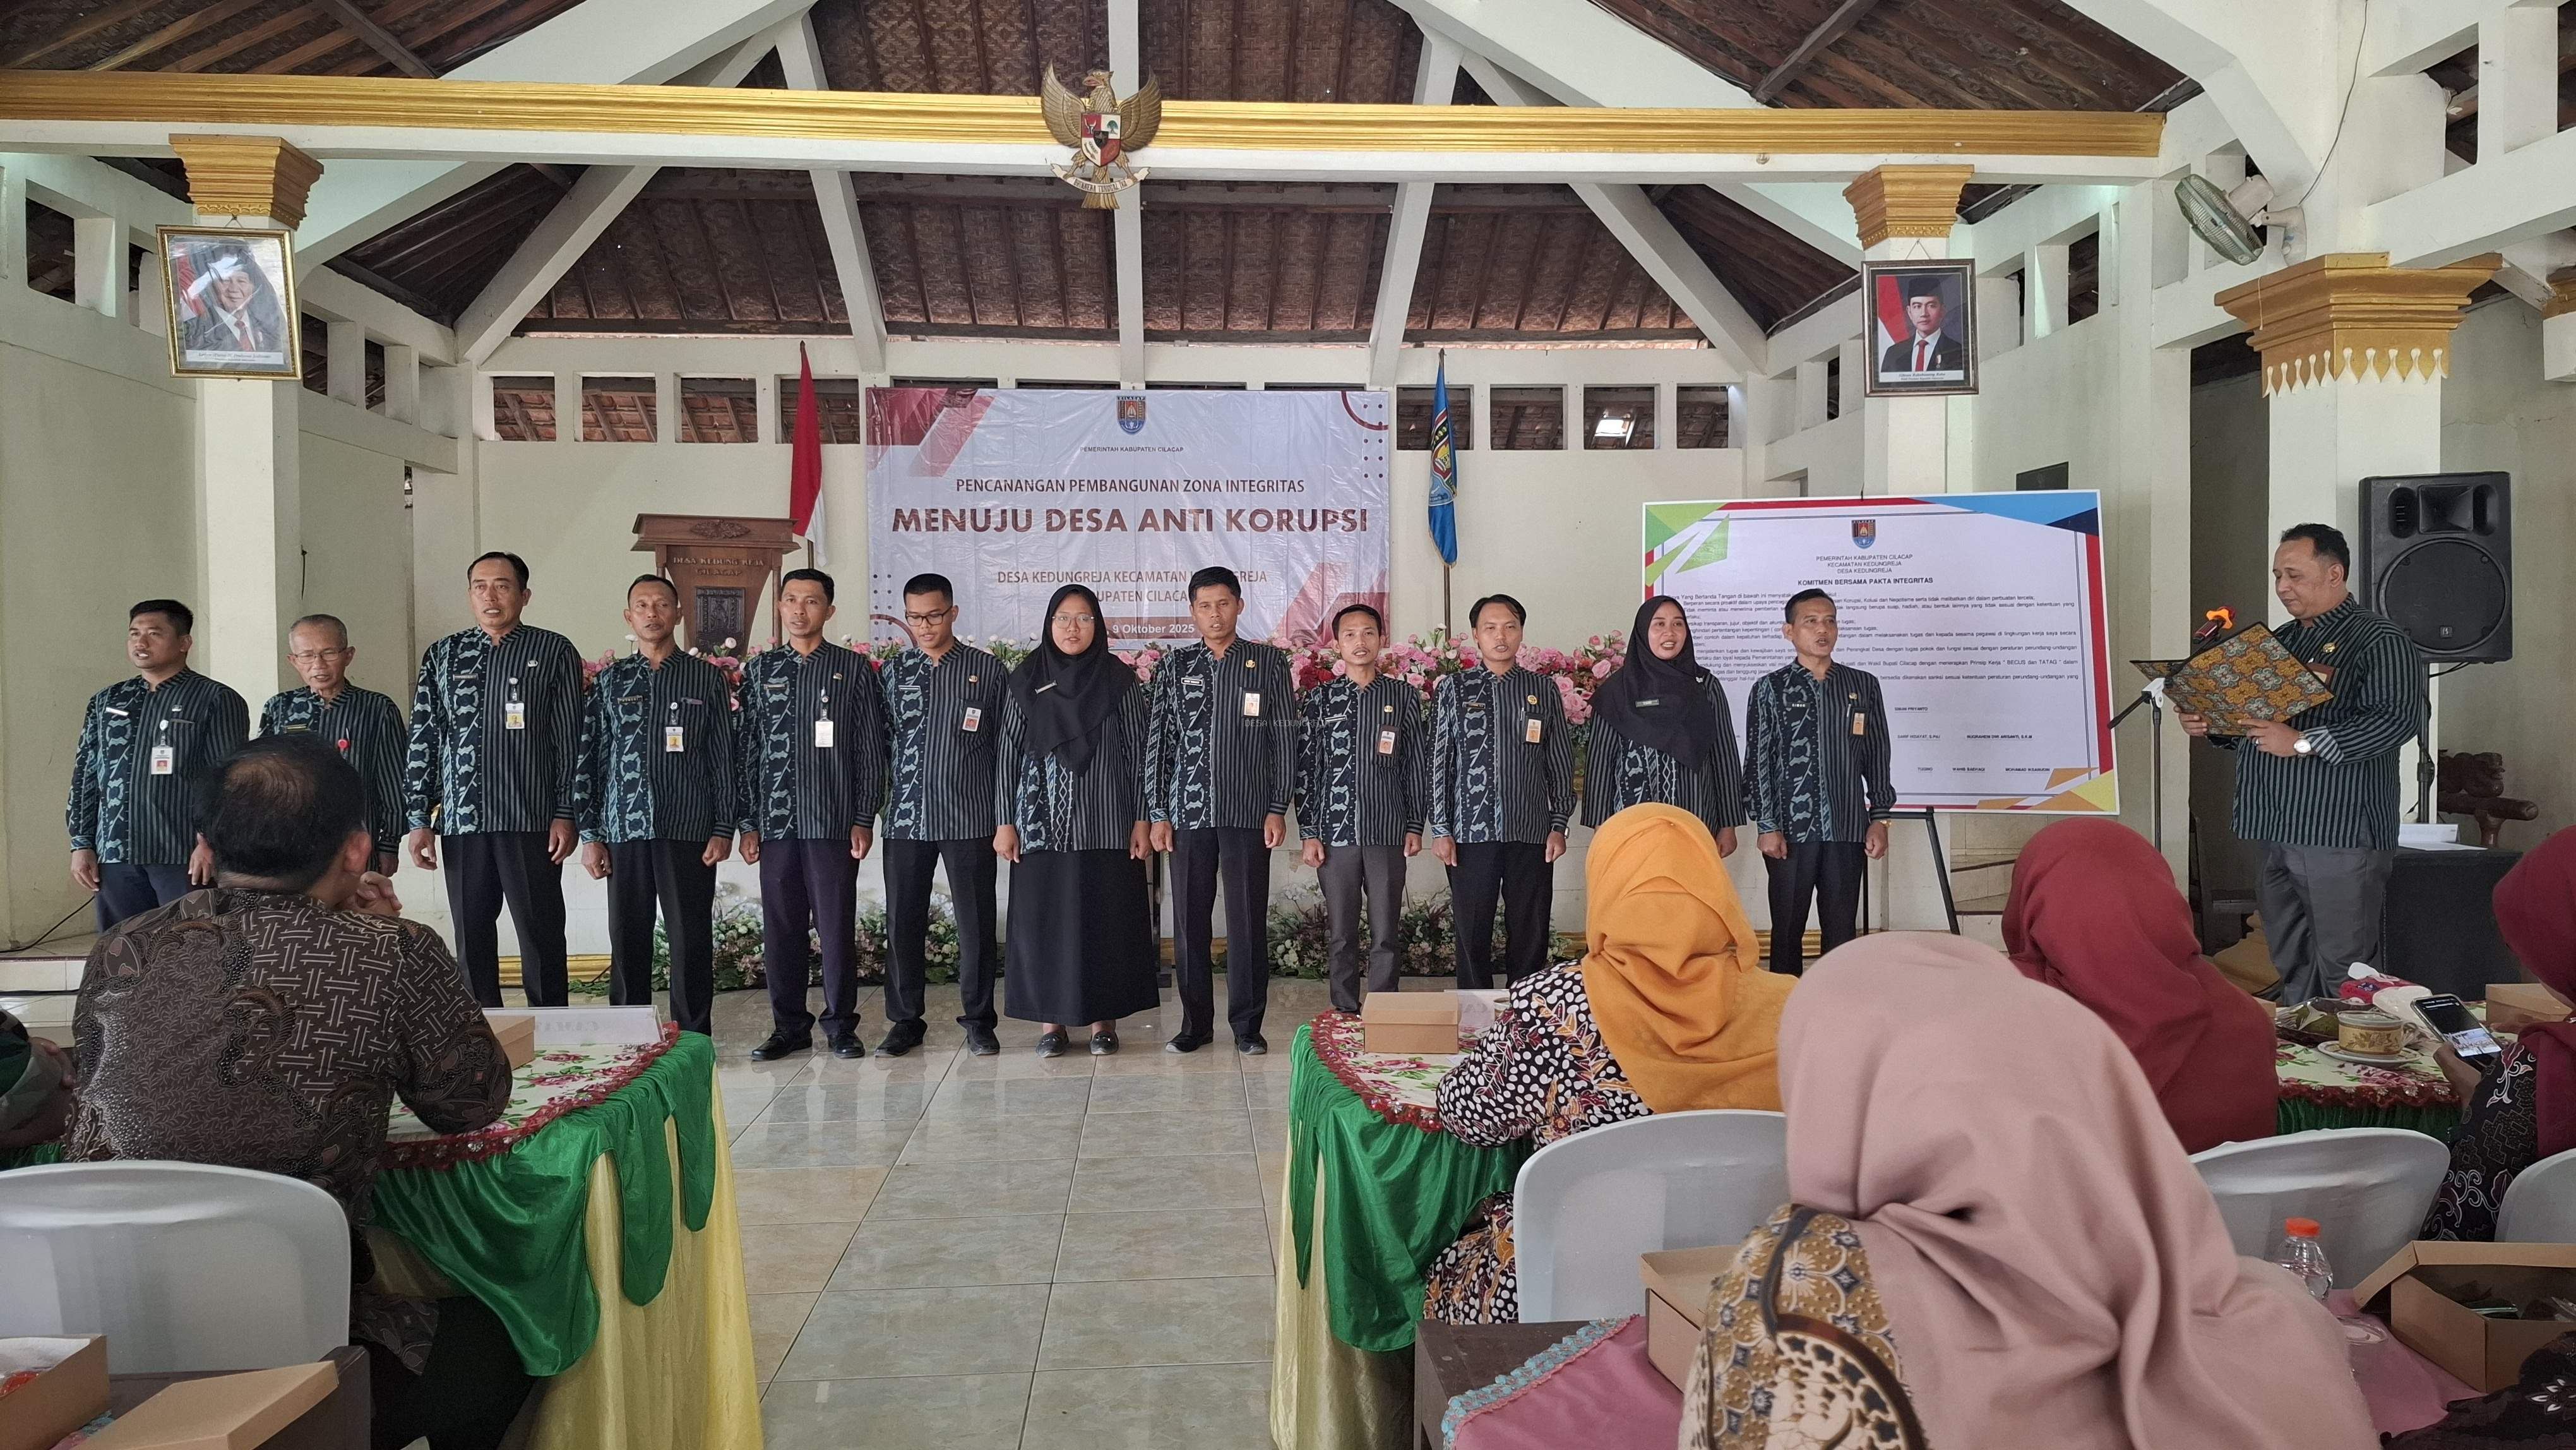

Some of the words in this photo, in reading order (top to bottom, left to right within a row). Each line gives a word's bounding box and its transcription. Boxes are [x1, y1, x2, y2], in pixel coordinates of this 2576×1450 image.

[957, 479, 1065, 492] PENCANANGAN
[1070, 479, 1179, 492] PEMBANGUNAN
[1183, 479, 1222, 493] ZONA
[1226, 479, 1304, 493] INTEGRITAS
[892, 508, 1032, 532] MENUJU
[1046, 508, 1128, 532] DESA
[1138, 508, 1213, 532] ANTI
[1226, 508, 1367, 532] KORUPSI
[998, 572, 1029, 583] DESA
[1032, 572, 1109, 583] KEDUNGREJA
[1114, 571, 1186, 582] KECAMATAN
[1122, 624, 1166, 633] Oktober
[1169, 624, 1195, 633] 2025
